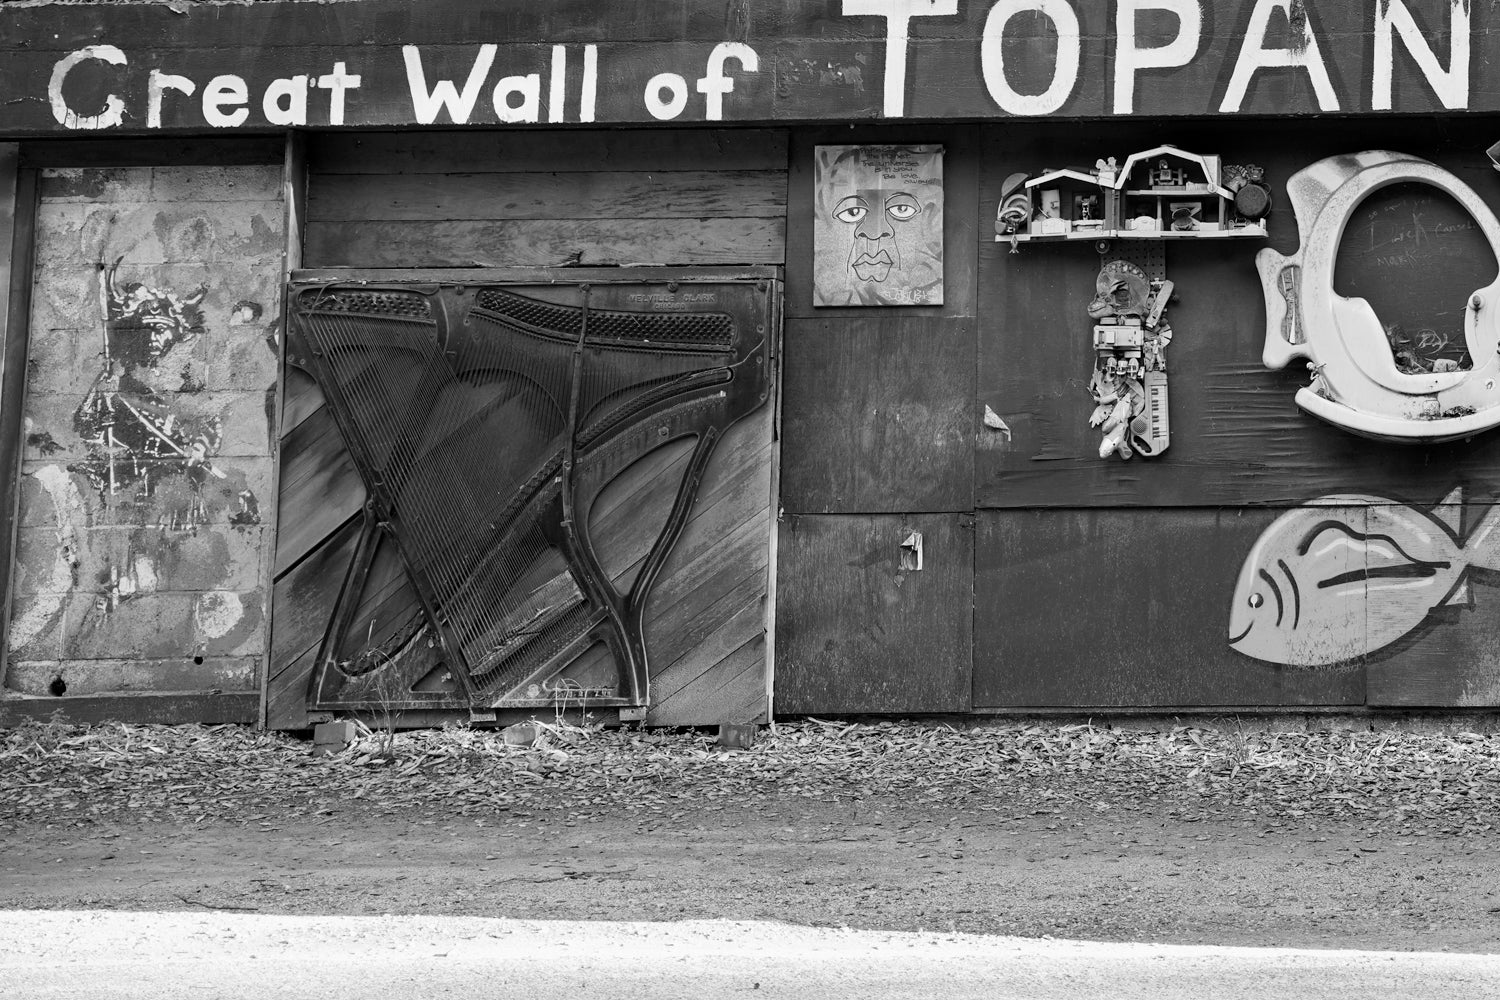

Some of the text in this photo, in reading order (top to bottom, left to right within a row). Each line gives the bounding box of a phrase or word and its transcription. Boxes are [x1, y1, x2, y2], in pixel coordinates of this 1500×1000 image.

[47, 44, 362, 130] Great
[402, 43, 598, 125] Wall
[643, 41, 759, 122] of
[682, 293, 716, 303] CLARK
